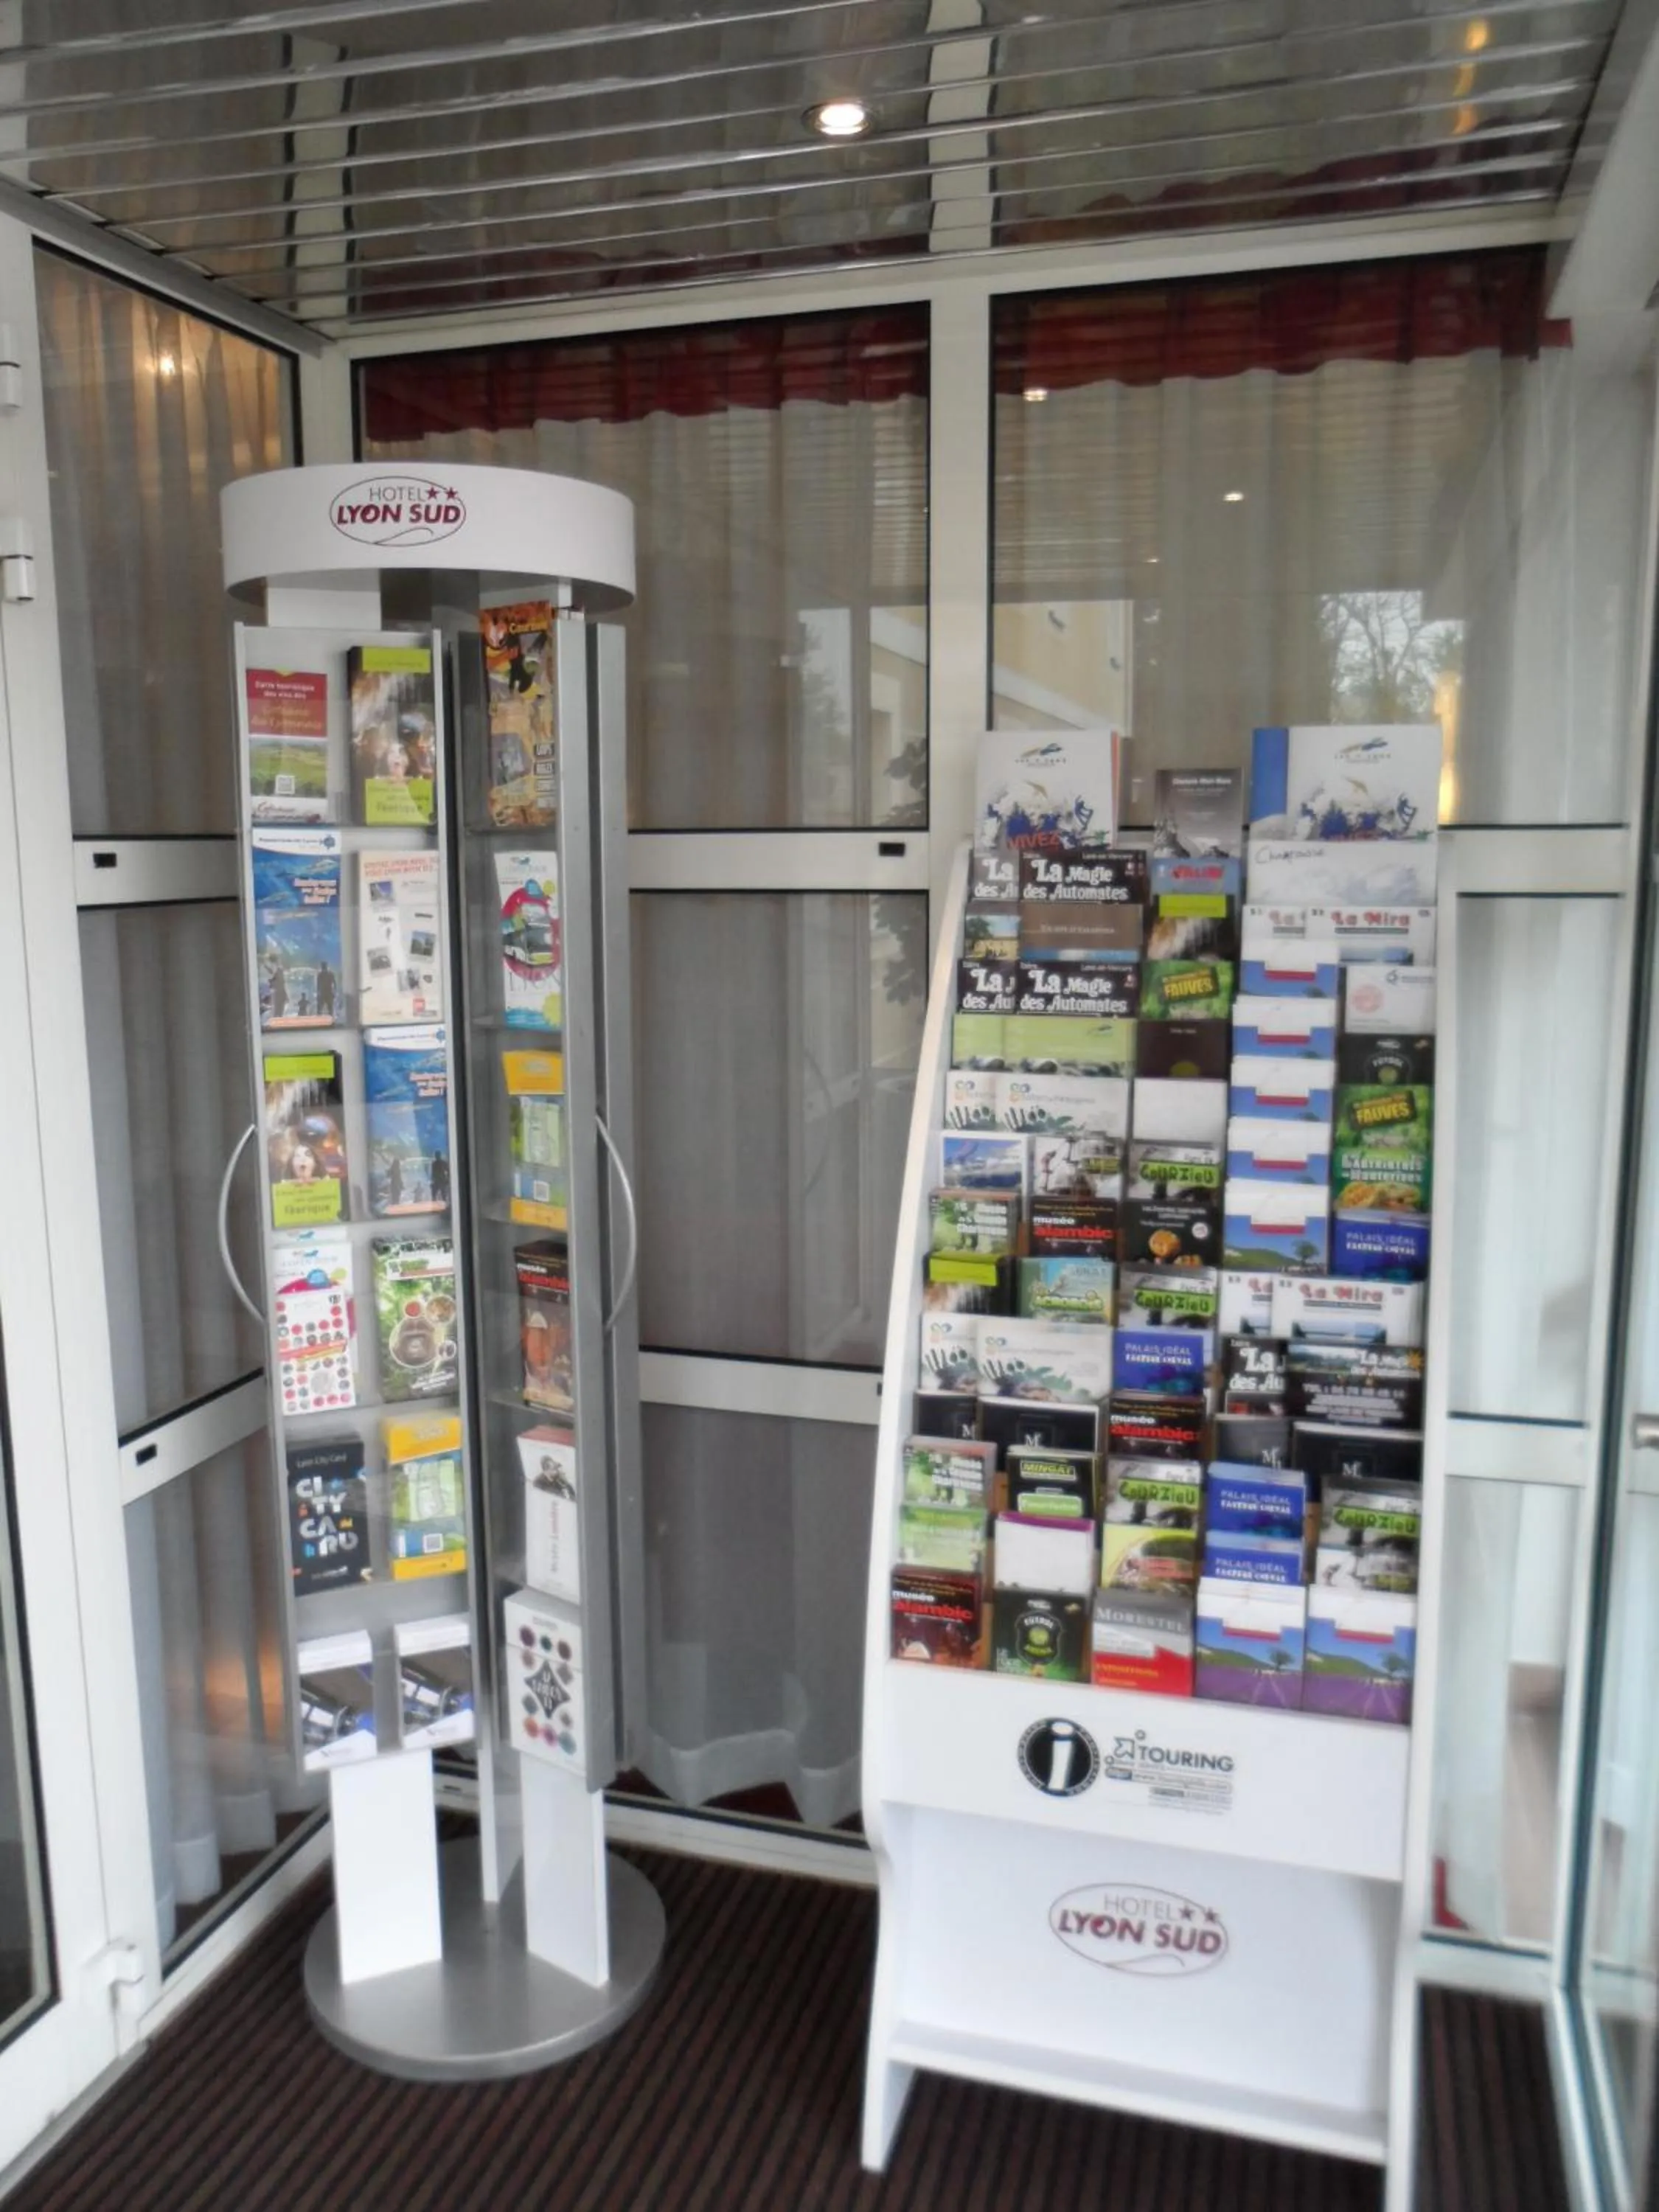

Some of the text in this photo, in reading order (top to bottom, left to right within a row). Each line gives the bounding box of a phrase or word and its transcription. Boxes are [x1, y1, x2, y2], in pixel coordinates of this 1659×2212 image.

[369, 486, 425, 501] HOTEL
[337, 504, 461, 524] LYON SUD
[1031, 859, 1113, 885] La Magie
[1023, 884, 1129, 900] des Automates
[970, 968, 1002, 992] La
[1028, 970, 1113, 996] La Magie
[1163, 976, 1214, 1001] FAUVES
[962, 993, 987, 1009] des
[1020, 994, 1128, 1013] des Automates
[1357, 1102, 1410, 1124] FAUVES
[1239, 1348, 1274, 1371] La
[1230, 1373, 1256, 1390] des
[1138, 1745, 1234, 1772] TOURING
[1103, 1893, 1178, 1921] HOTEL
[1058, 1908, 1221, 1954] LYON SUD
